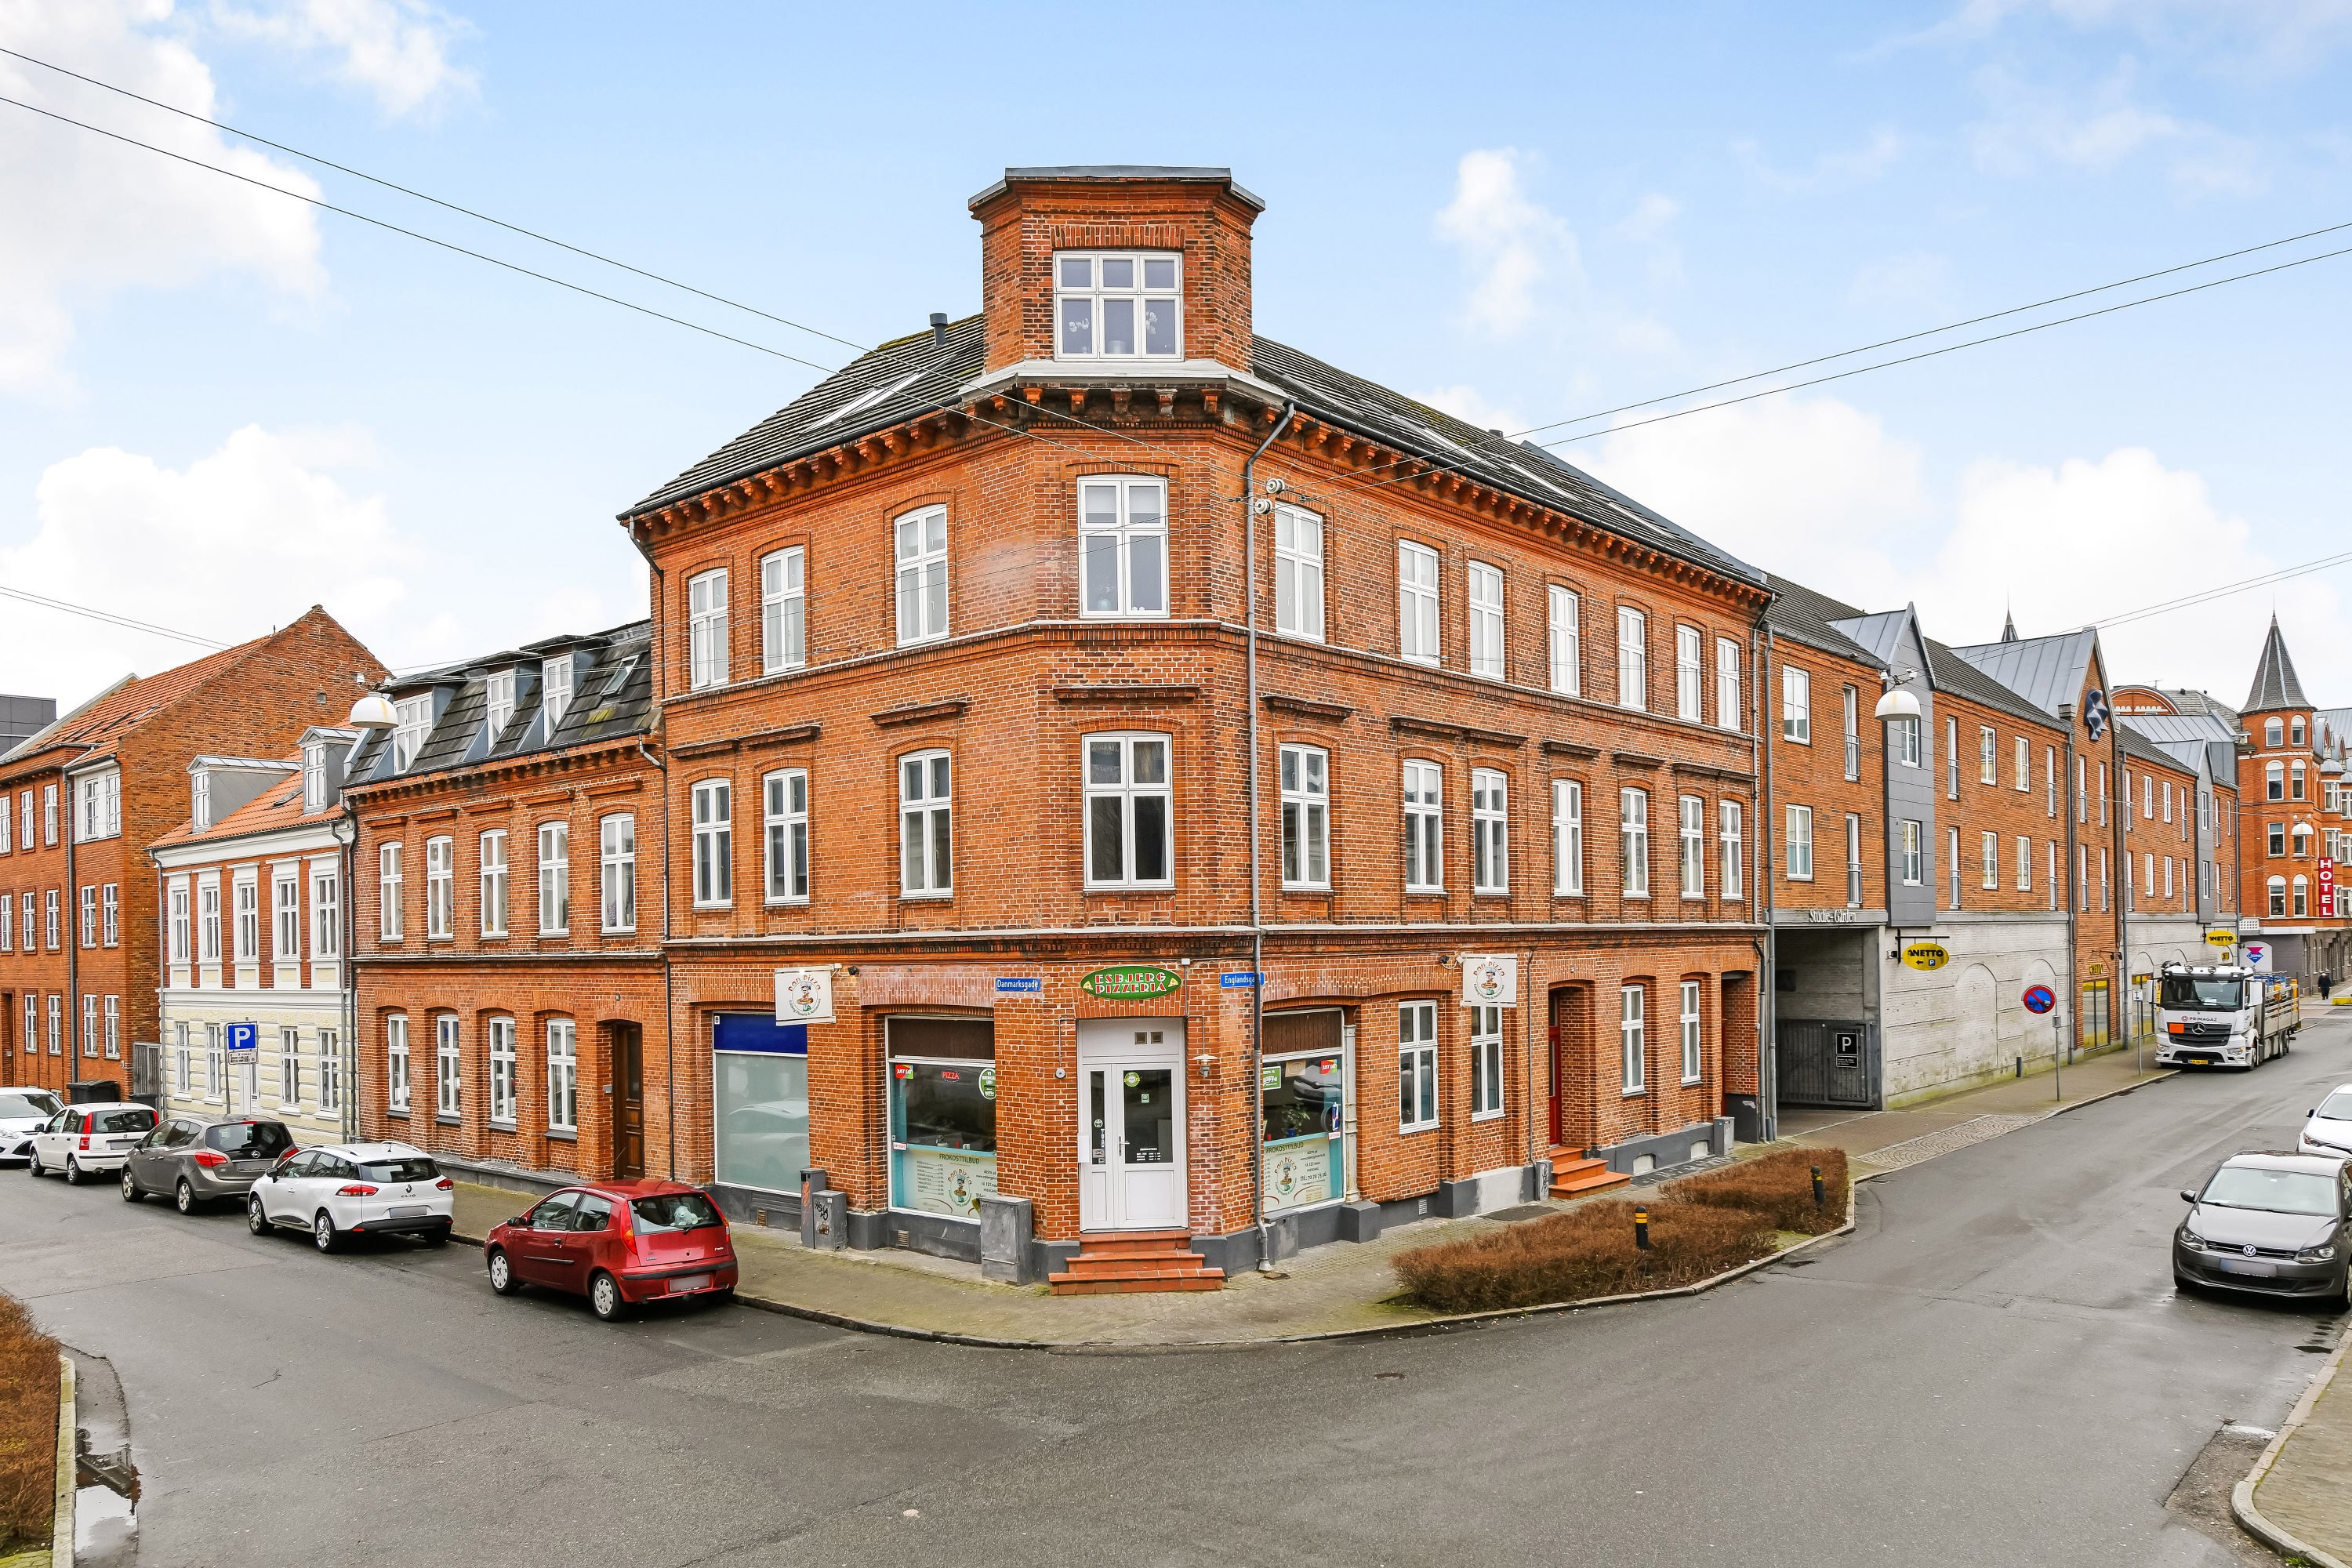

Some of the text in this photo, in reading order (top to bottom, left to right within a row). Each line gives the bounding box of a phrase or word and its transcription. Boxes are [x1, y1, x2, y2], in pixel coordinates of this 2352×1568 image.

[2319, 859, 2332, 916] HOTEL
[1095, 972, 1166, 984] ESBJERG
[1225, 975, 1254, 985] Englandsga
[996, 979, 1039, 991] Danmarksgade
[1095, 982, 1167, 993] PIZZERIA
[234, 1027, 251, 1047] P
[1842, 1036, 1852, 1051] P
[942, 1071, 960, 1080] PIZZA
[1265, 1142, 1304, 1153] FROKOSTTILBUD
[939, 1153, 980, 1164] FROKOSTTILBUD
